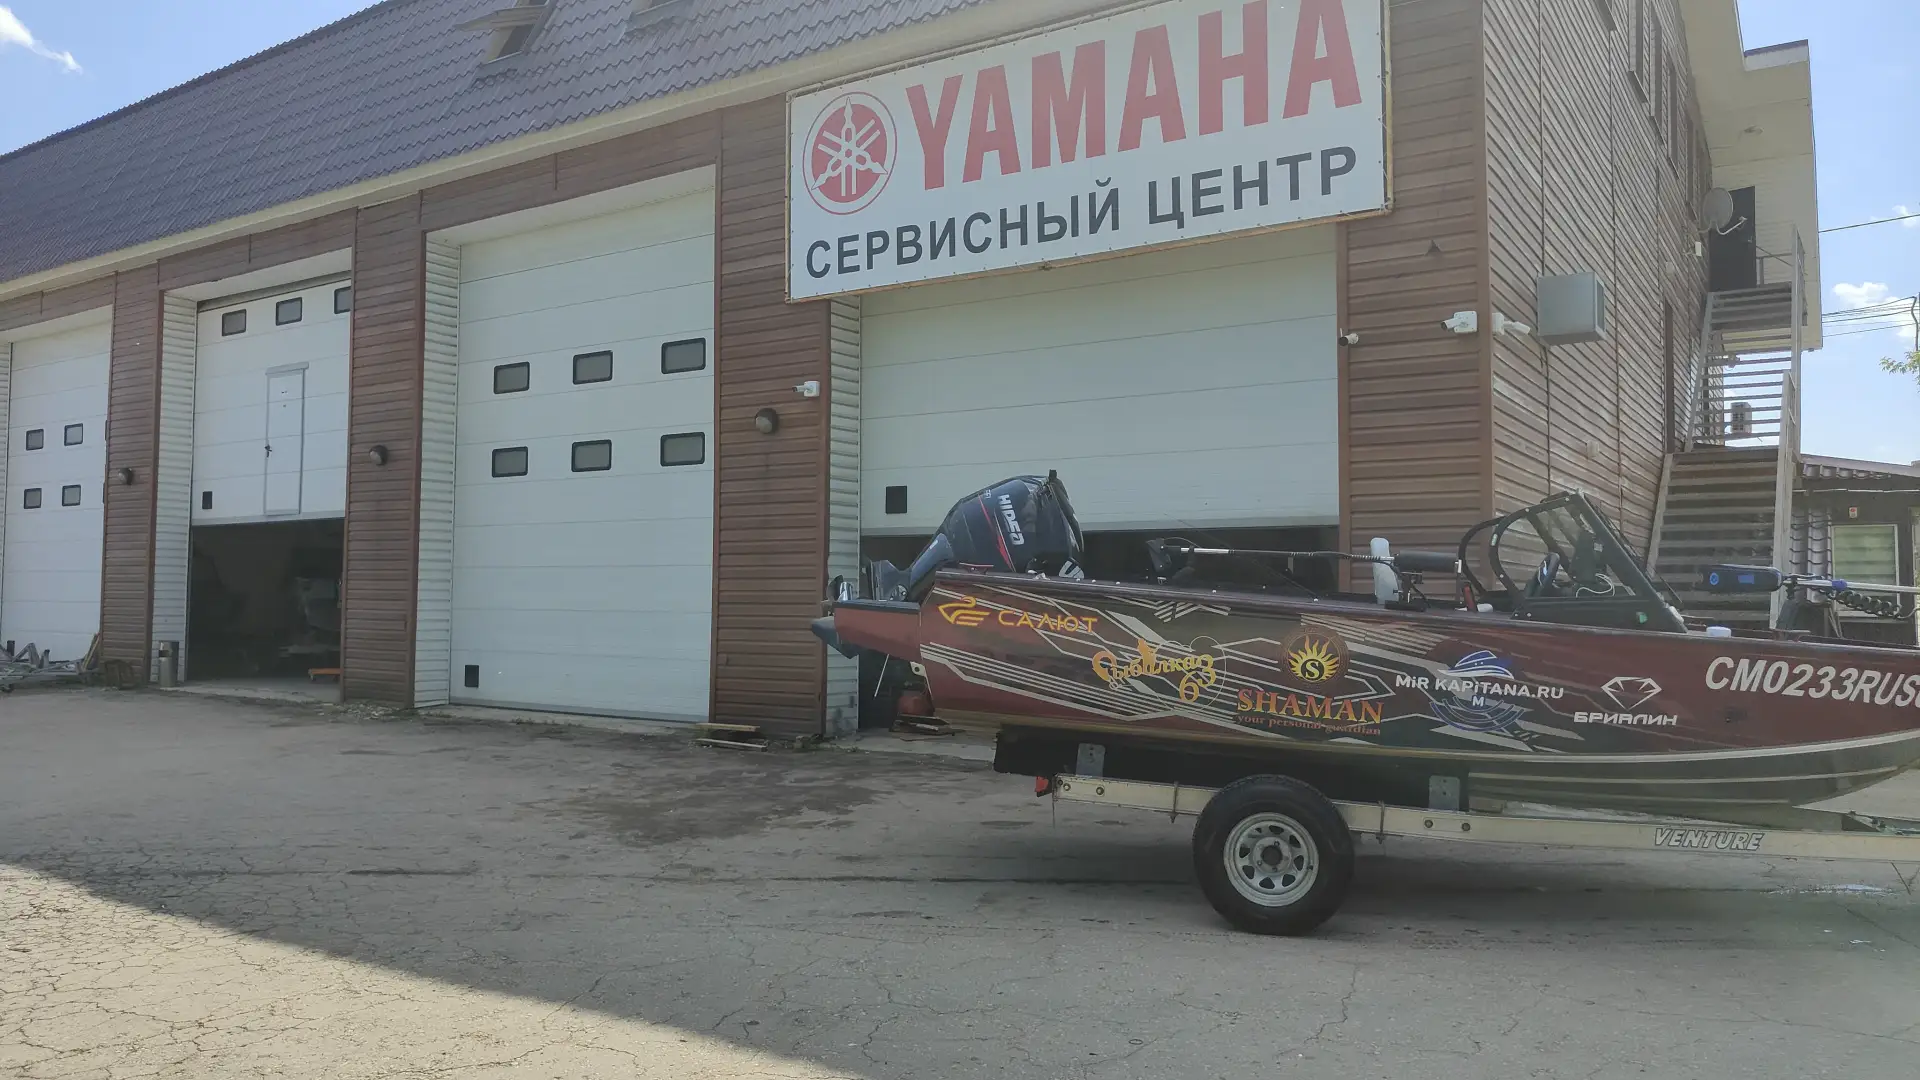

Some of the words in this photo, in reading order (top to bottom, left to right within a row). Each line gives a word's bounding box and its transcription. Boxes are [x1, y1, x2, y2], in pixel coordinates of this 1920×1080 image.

[906, 0, 1362, 191] YAMAHA
[806, 177, 1120, 279] СЕРВИСНЫЙ
[1147, 146, 1357, 230] ЦЕНТР
[998, 610, 1098, 632] САЛЮТ
[1237, 688, 1384, 724] SHAMAN
[1238, 714, 1264, 724] your
[1268, 718, 1322, 729] personal
[1325, 724, 1381, 736] guardian
[1654, 827, 1765, 851] VENTURE
